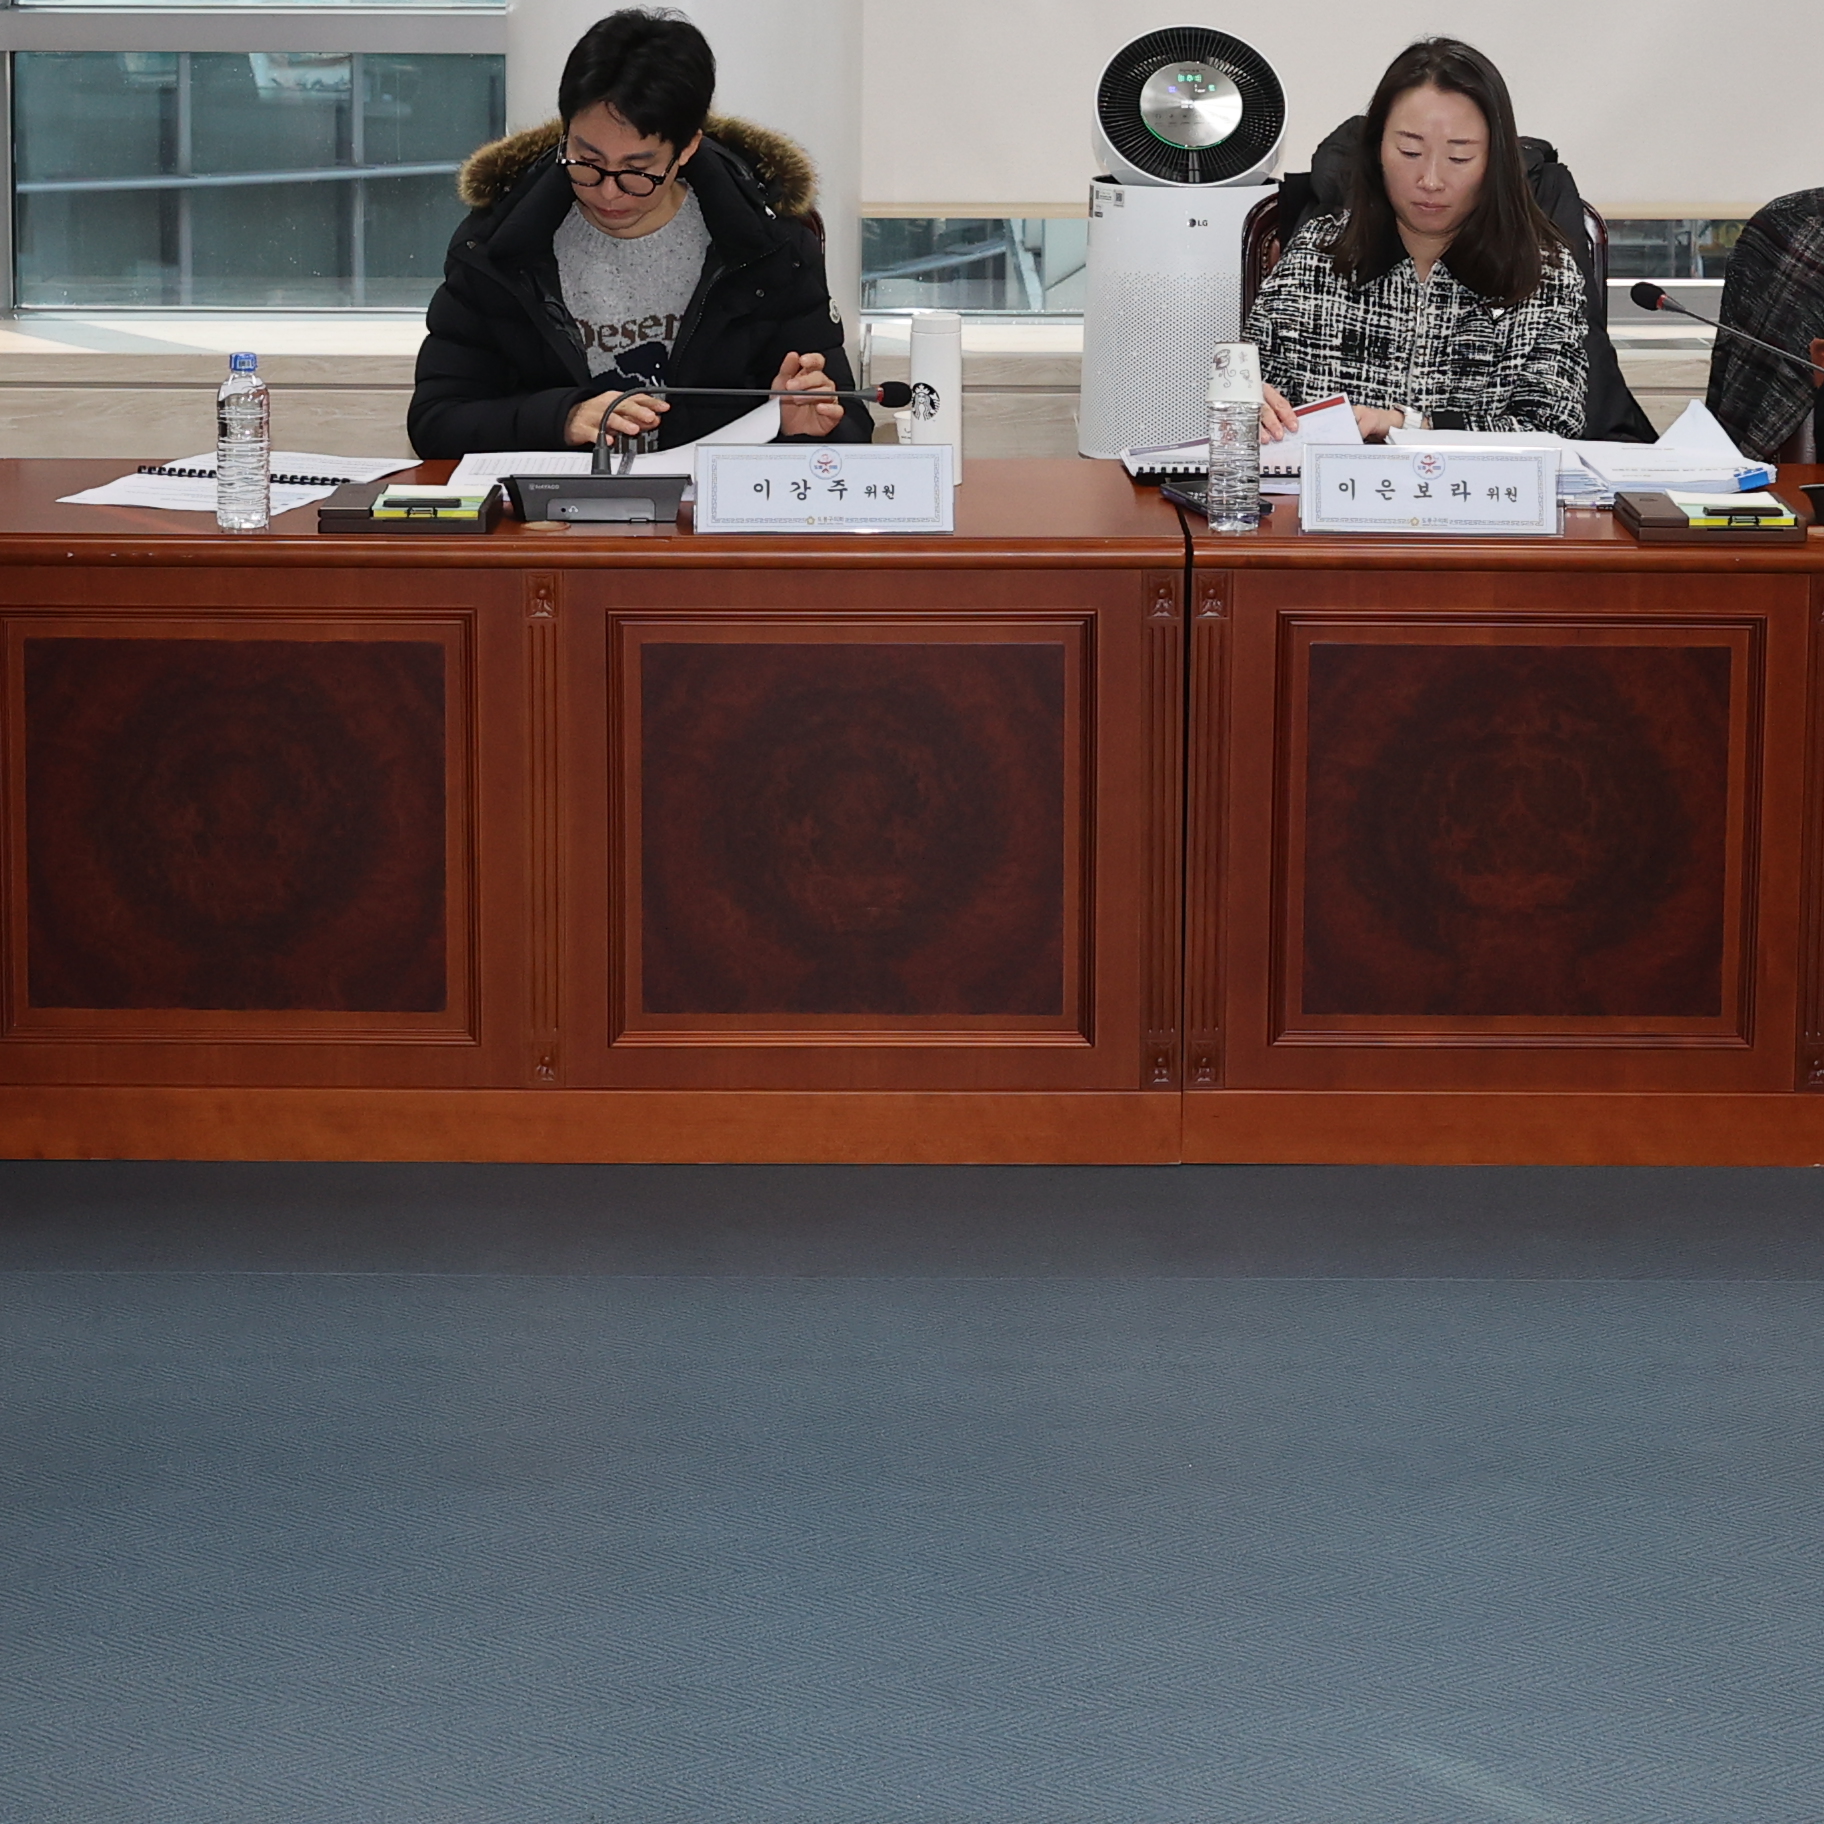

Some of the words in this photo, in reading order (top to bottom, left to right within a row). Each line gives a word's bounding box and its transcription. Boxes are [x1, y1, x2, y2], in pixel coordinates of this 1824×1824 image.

[1197, 219, 1208, 227] LG
[864, 484, 895, 500] 위원
[1486, 486, 1518, 503] 위원
